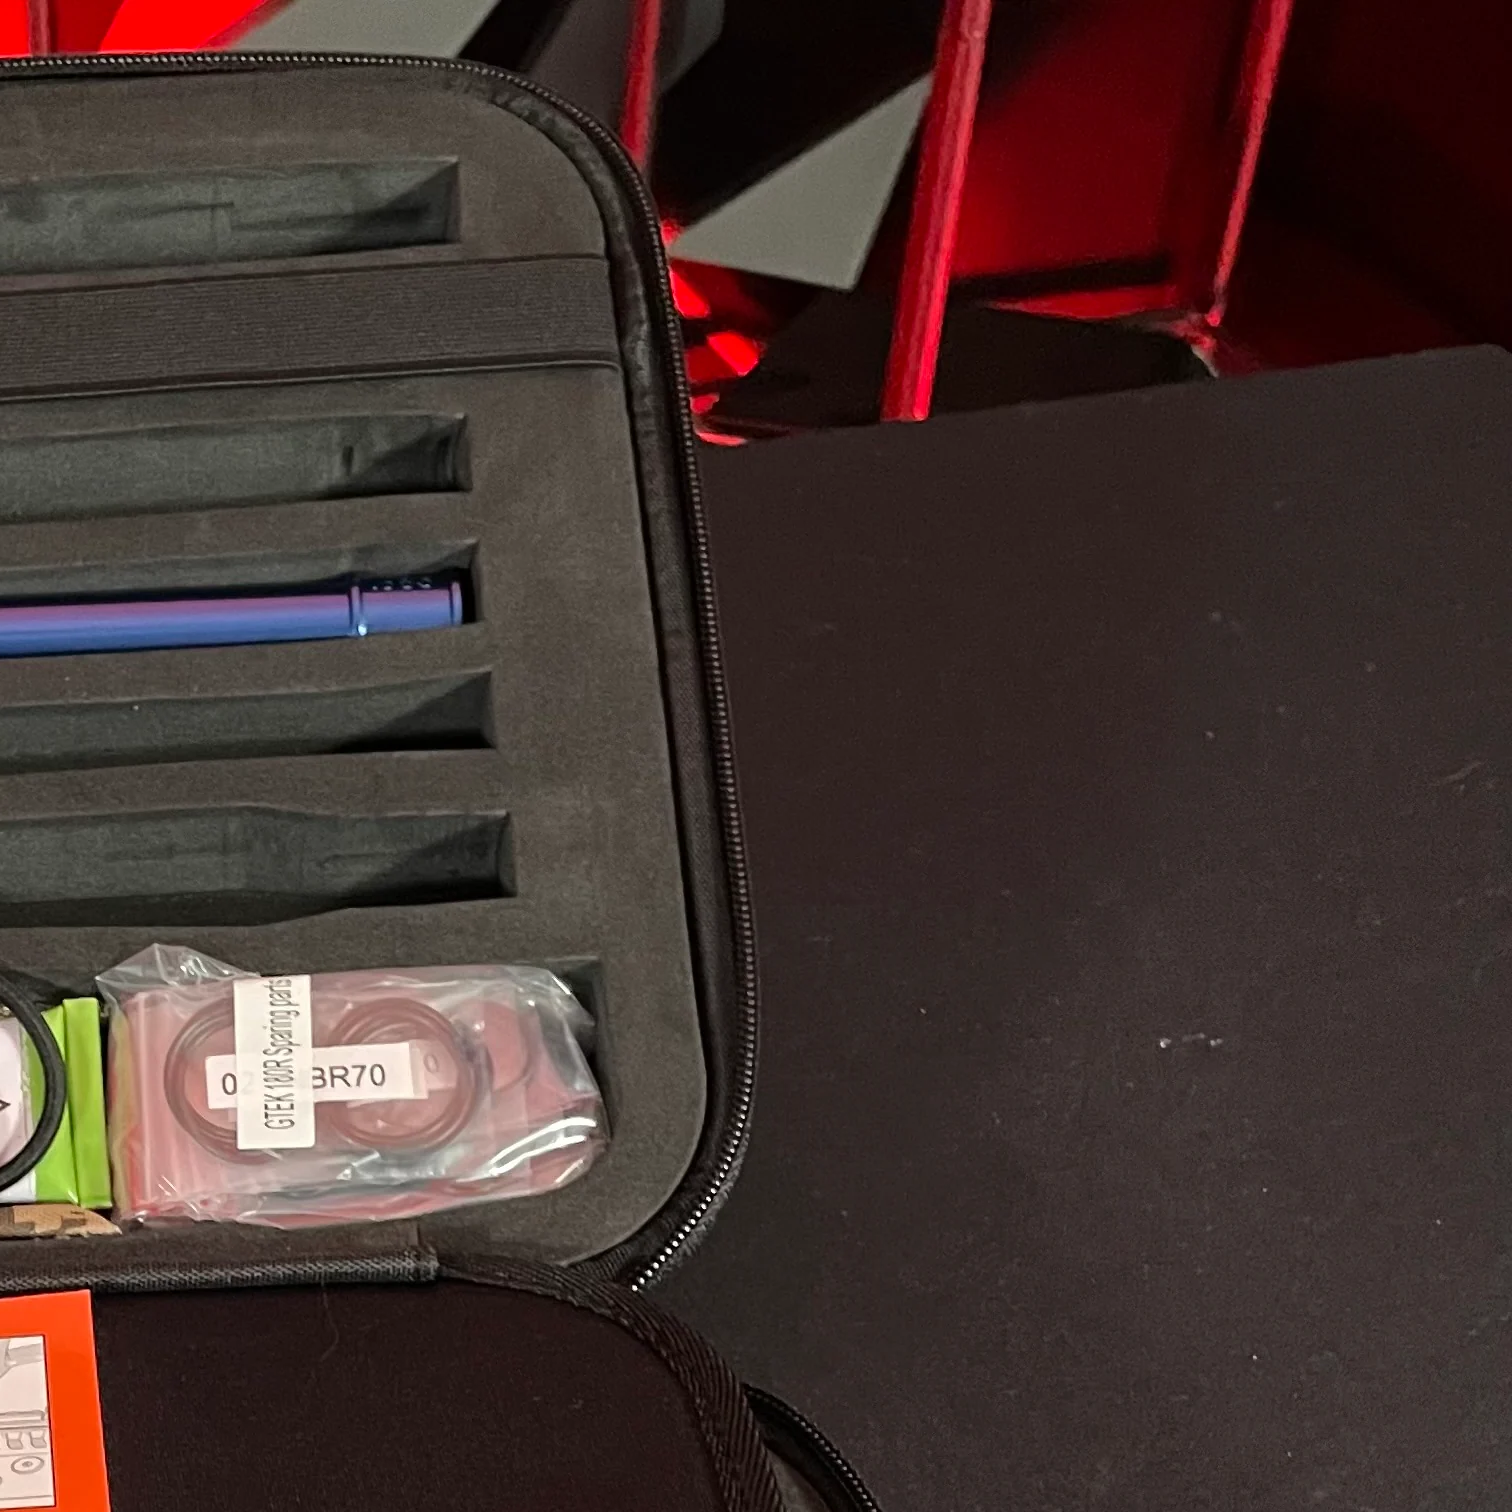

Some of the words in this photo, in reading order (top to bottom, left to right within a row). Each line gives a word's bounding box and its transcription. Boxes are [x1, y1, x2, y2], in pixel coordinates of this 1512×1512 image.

[264, 978, 300, 1008] parts
[262, 1009, 301, 1056] Sparing
[262, 1059, 295, 1090] 180R
[264, 1090, 296, 1130] GTEK
